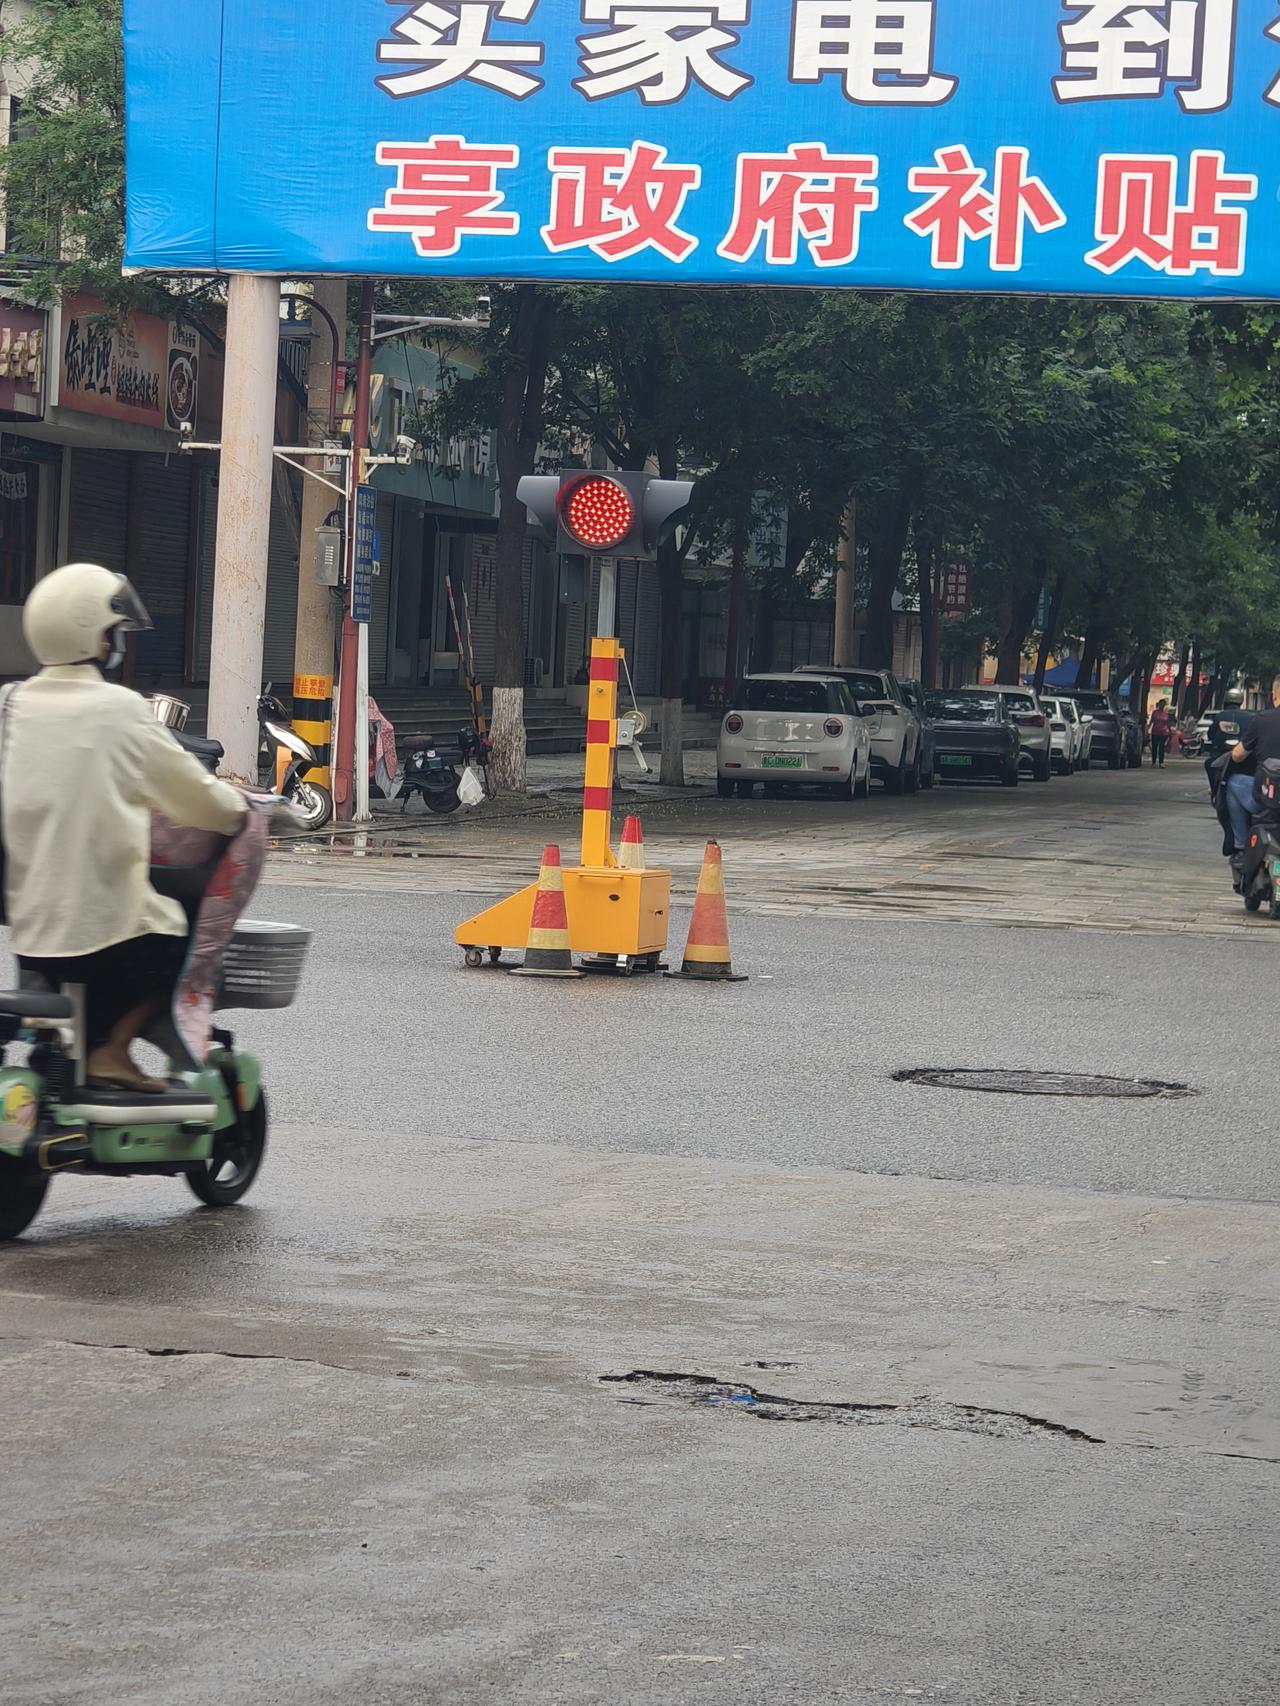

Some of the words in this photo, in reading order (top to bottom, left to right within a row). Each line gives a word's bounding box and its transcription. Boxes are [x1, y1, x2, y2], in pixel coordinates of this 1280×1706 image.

[1053, 0, 1280, 113] 到
[367, 134, 1259, 276] 享政府补贴
